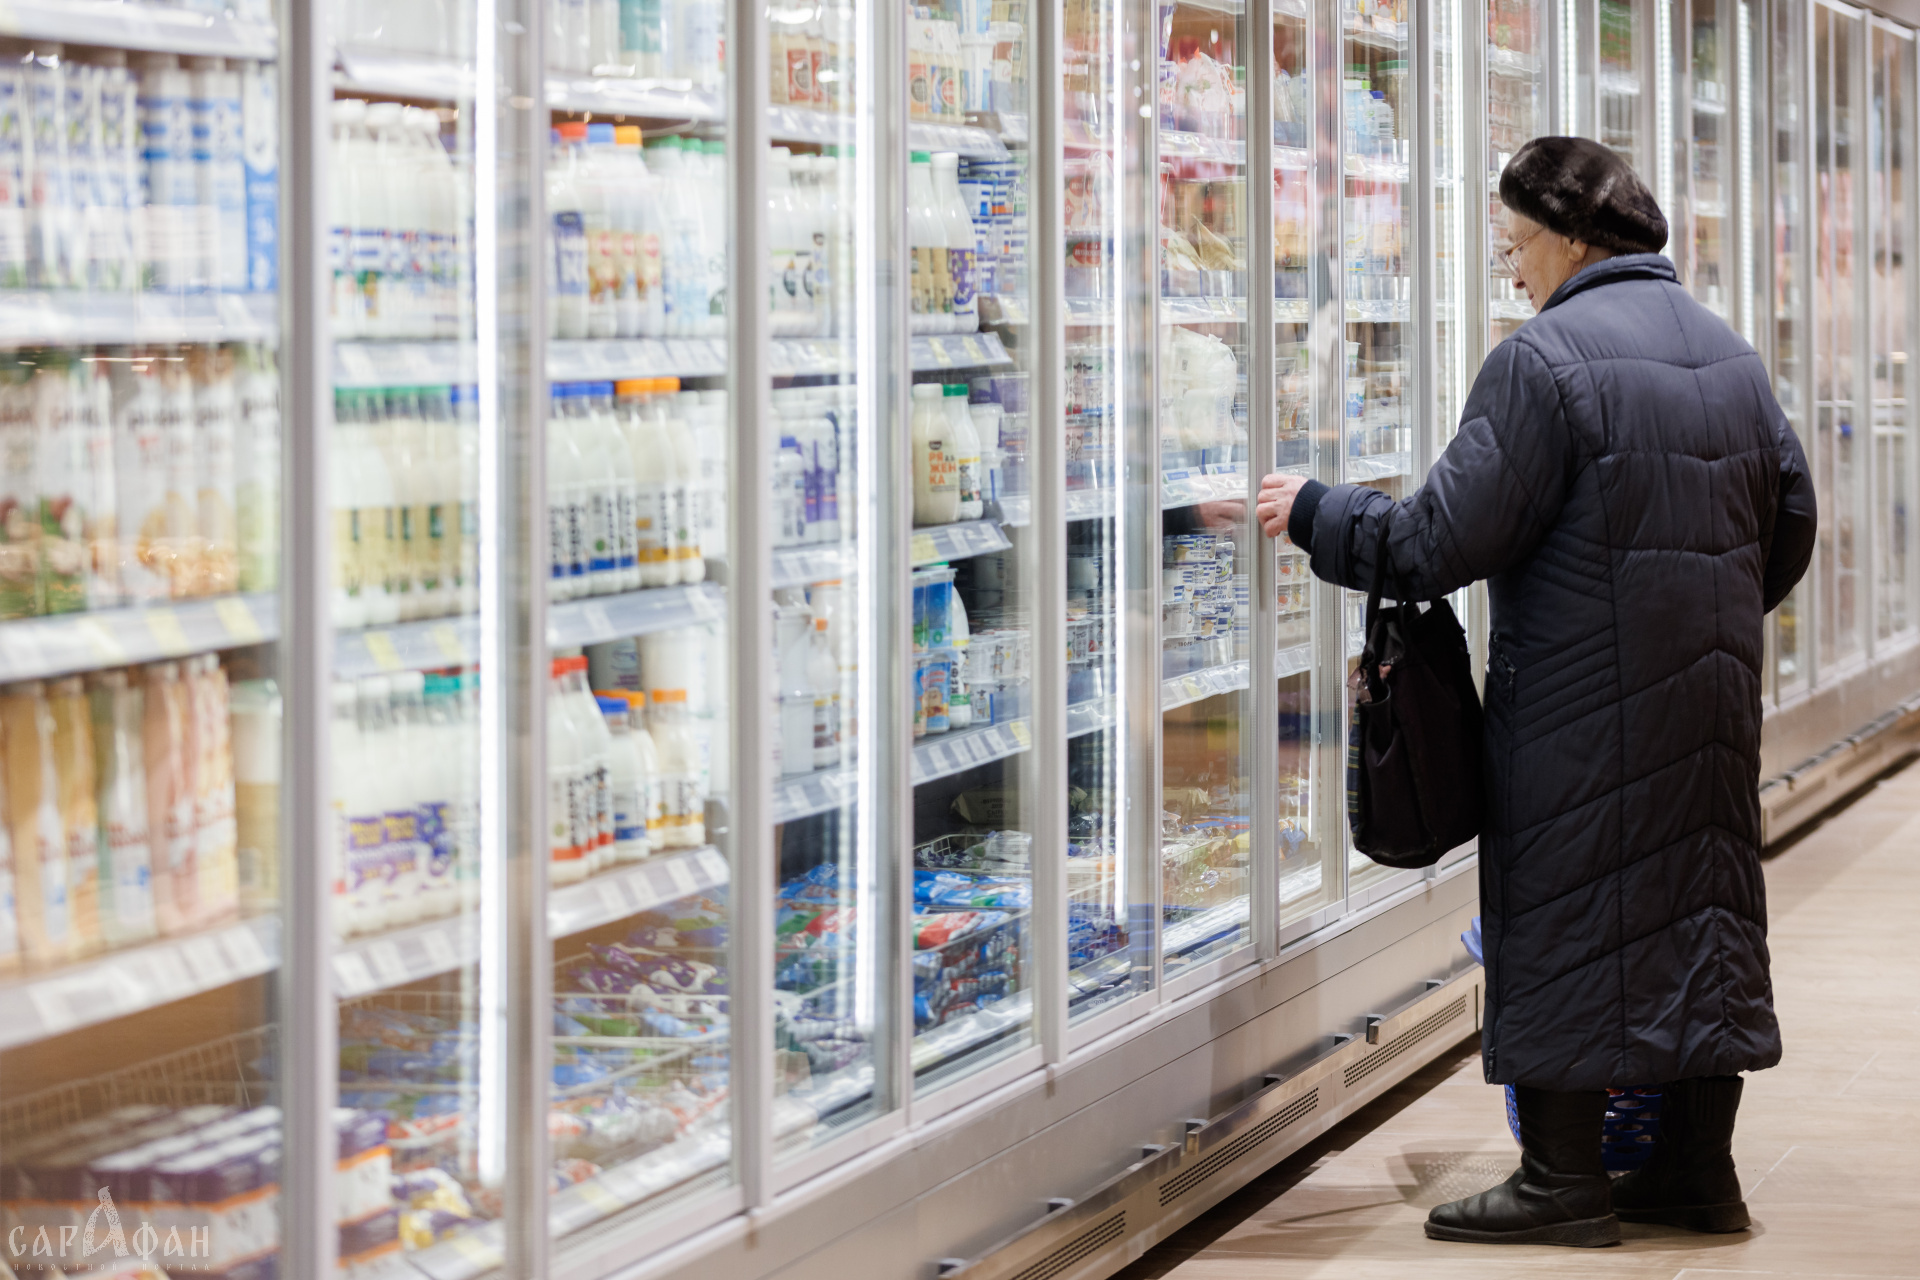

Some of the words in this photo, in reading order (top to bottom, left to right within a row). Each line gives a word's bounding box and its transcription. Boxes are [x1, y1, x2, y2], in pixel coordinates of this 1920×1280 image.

[929, 452, 943, 462] РЯ
[930, 463, 956, 473] ЖЕН
[929, 474, 945, 485] КА
